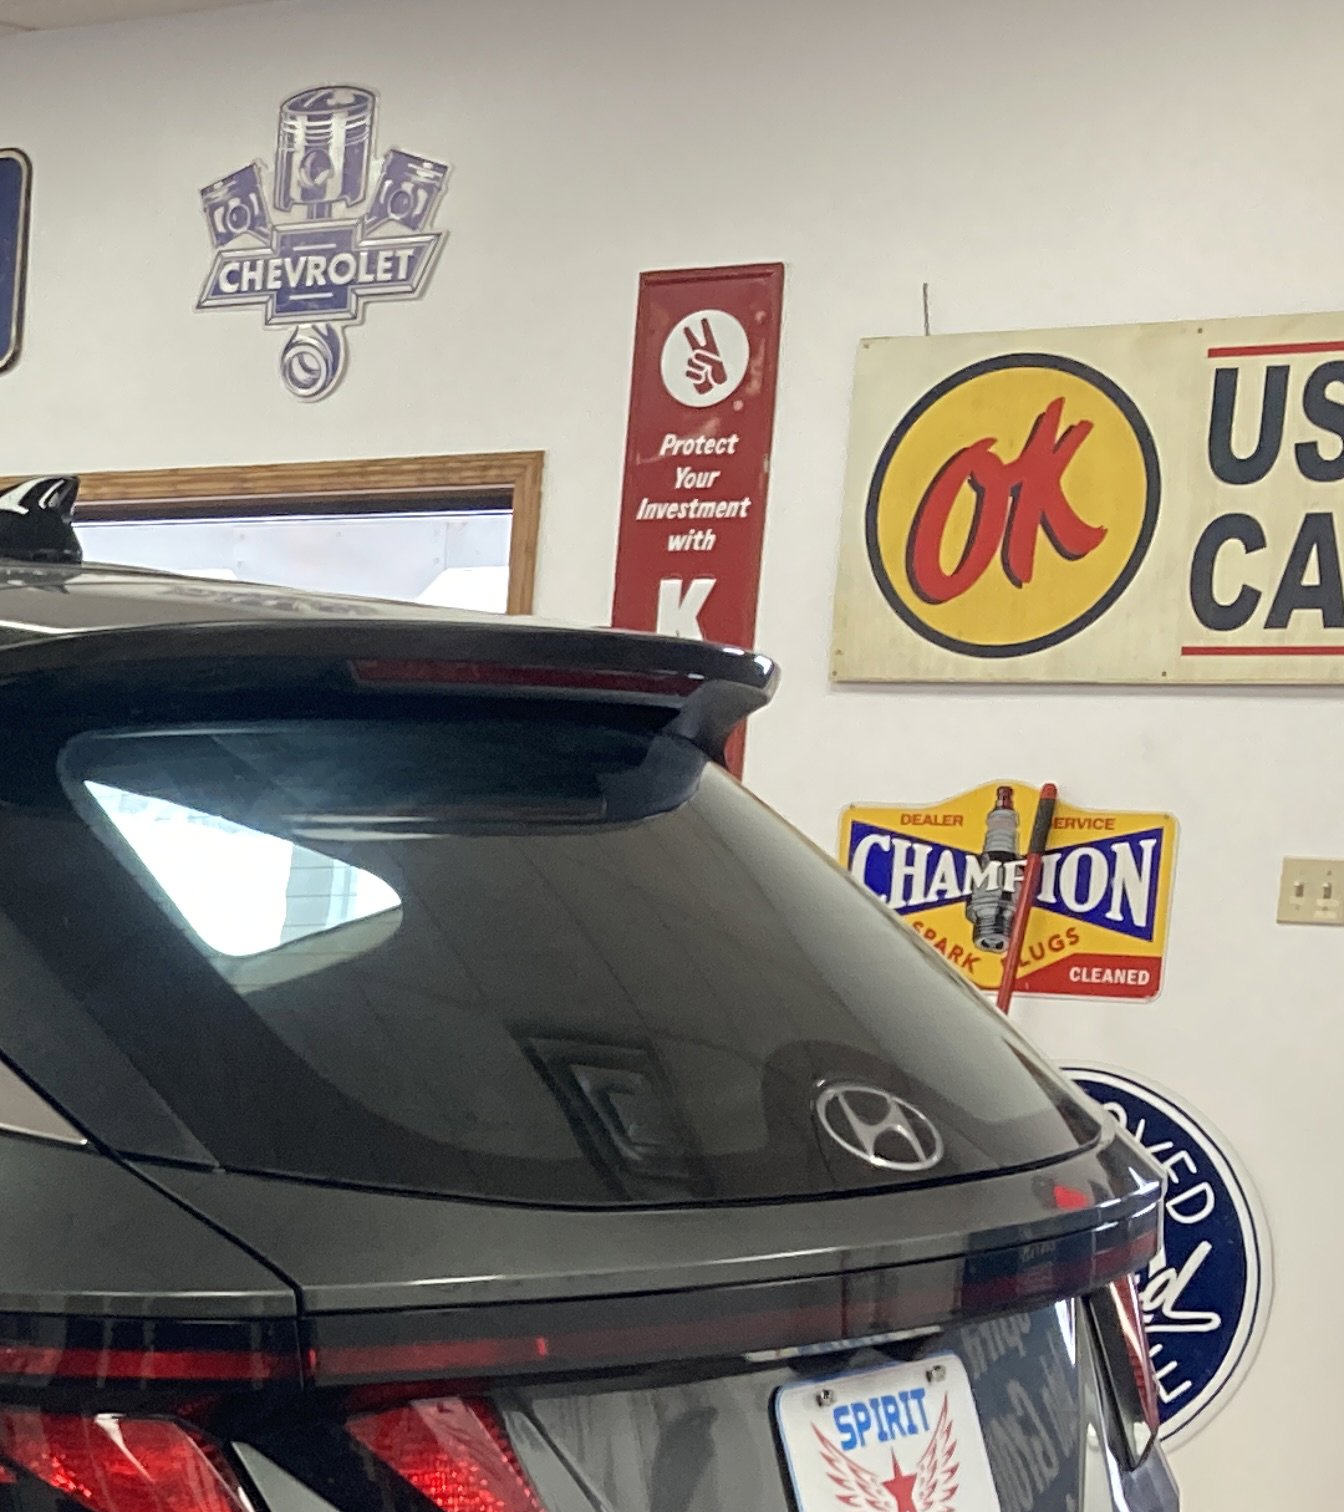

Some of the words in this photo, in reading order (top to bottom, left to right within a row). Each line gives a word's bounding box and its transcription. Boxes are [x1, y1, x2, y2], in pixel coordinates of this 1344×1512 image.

[218, 248, 415, 294] CHEVROLET
[659, 433, 739, 456] Protect
[674, 466, 721, 490] Your
[635, 497, 752, 521] Investment
[904, 396, 1109, 606] OK
[667, 528, 716, 552] with
[1189, 511, 1344, 632] CA
[656, 577, 717, 641] K
[900, 813, 964, 827] DEALER
[1051, 815, 1117, 831] ERVICE
[852, 833, 1158, 928] CHAMPION
[1001, 926, 1080, 968] LUGS
[1069, 966, 1150, 986] CLEANED
[832, 1387, 930, 1451] SPIRIT
